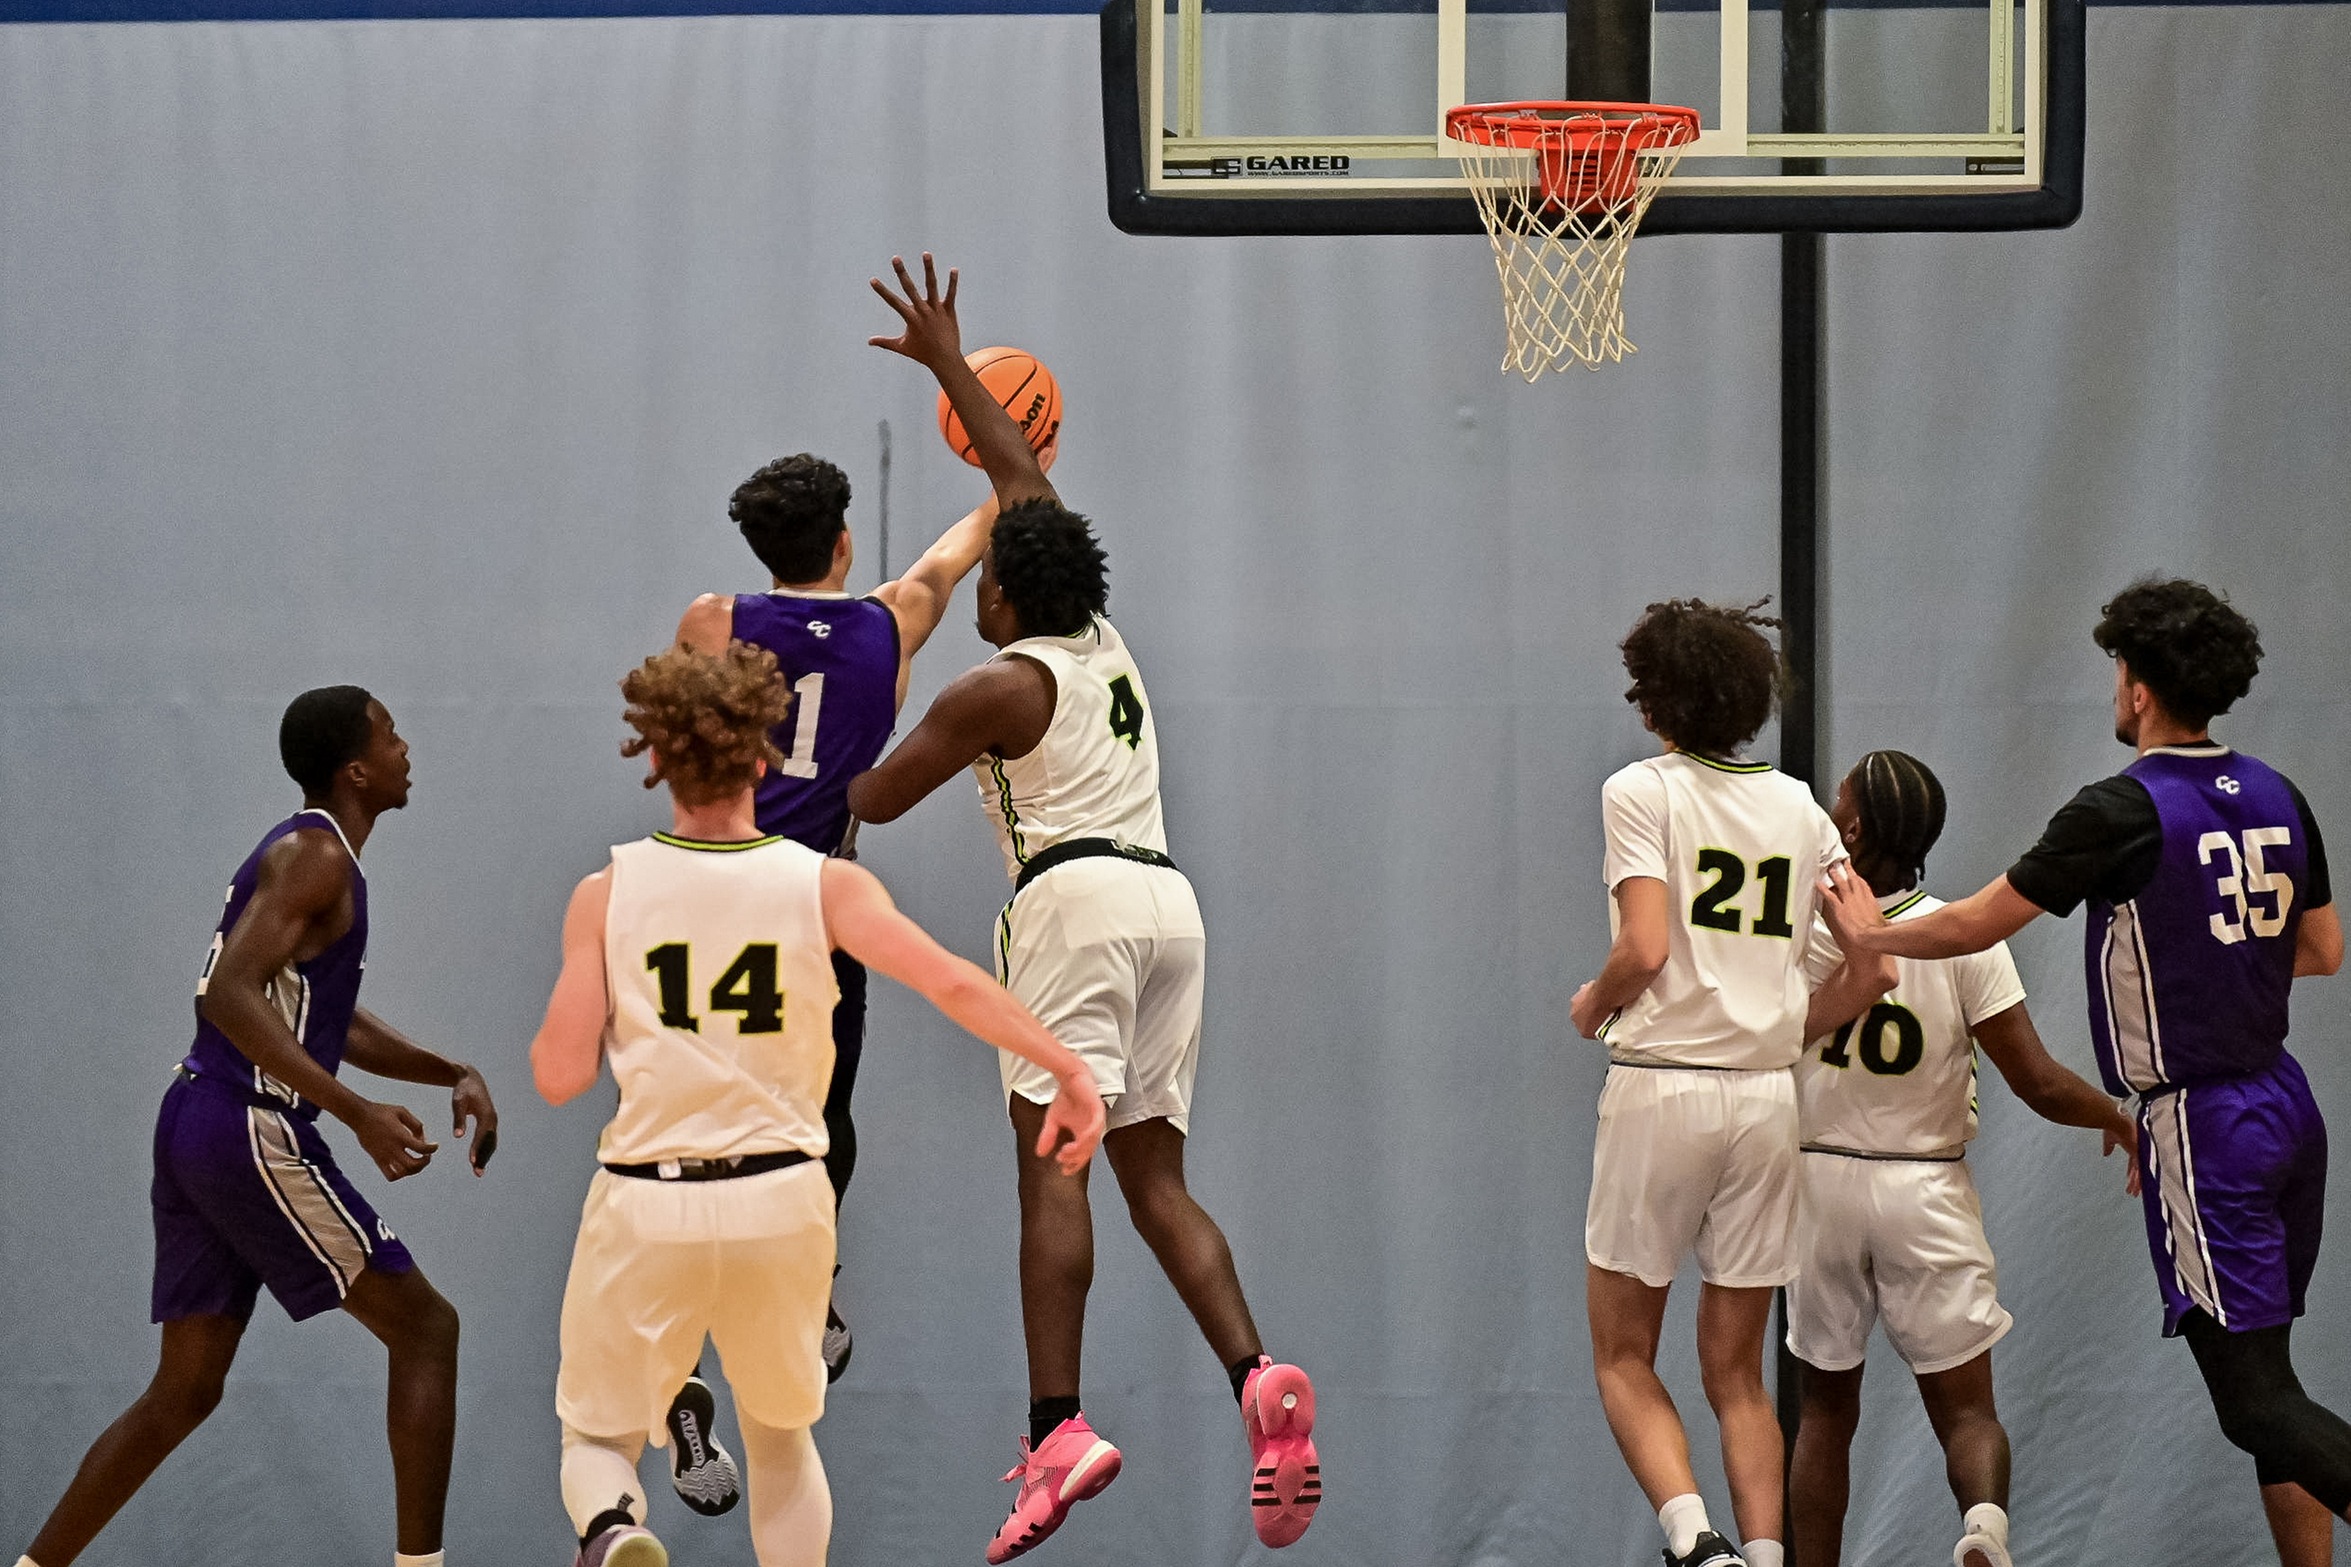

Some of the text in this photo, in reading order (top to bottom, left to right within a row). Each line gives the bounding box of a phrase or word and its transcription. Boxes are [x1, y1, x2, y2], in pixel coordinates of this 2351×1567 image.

[1246, 155, 1350, 170] GARED
[782, 672, 825, 779] 1
[1107, 672, 1145, 752] 4
[1690, 846, 1793, 940] 21
[2198, 826, 2294, 945] 35
[645, 940, 784, 1035] 14
